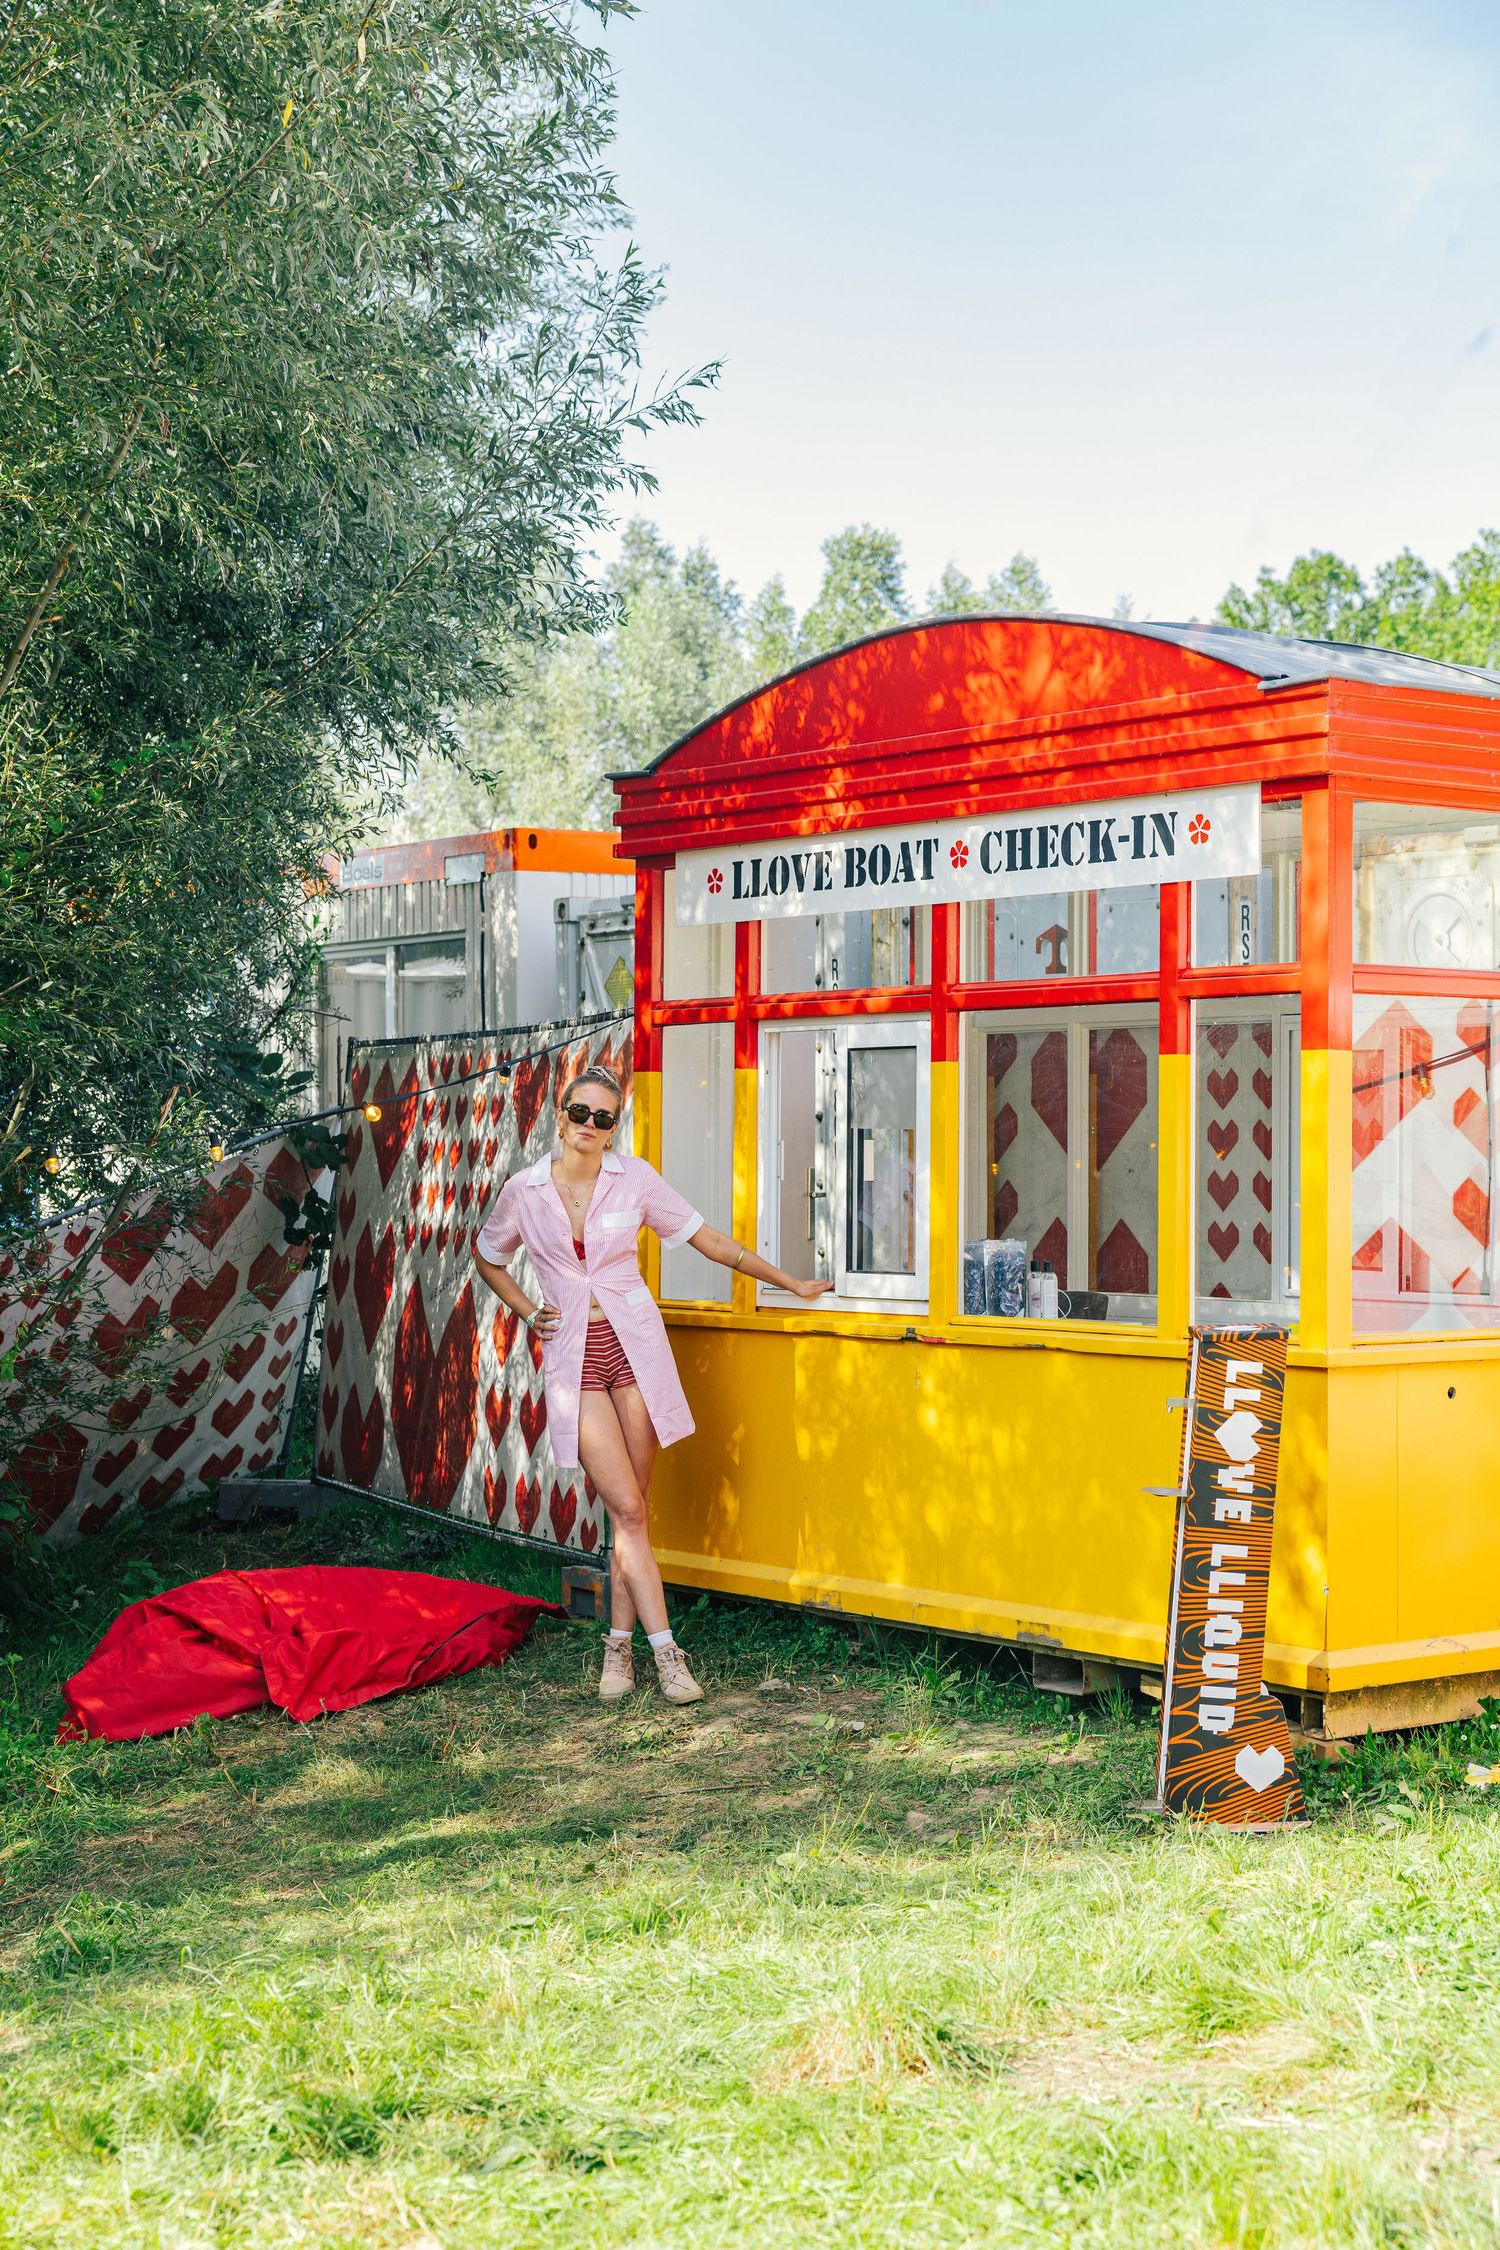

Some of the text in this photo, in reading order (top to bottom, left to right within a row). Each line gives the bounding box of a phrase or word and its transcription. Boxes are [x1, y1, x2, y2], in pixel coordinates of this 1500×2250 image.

[731, 810, 1178, 900] LLOVE BOAT CHECK-IN
[1241, 904, 1250, 965] RS
[1197, 1543, 1249, 1735] LLIQUID
